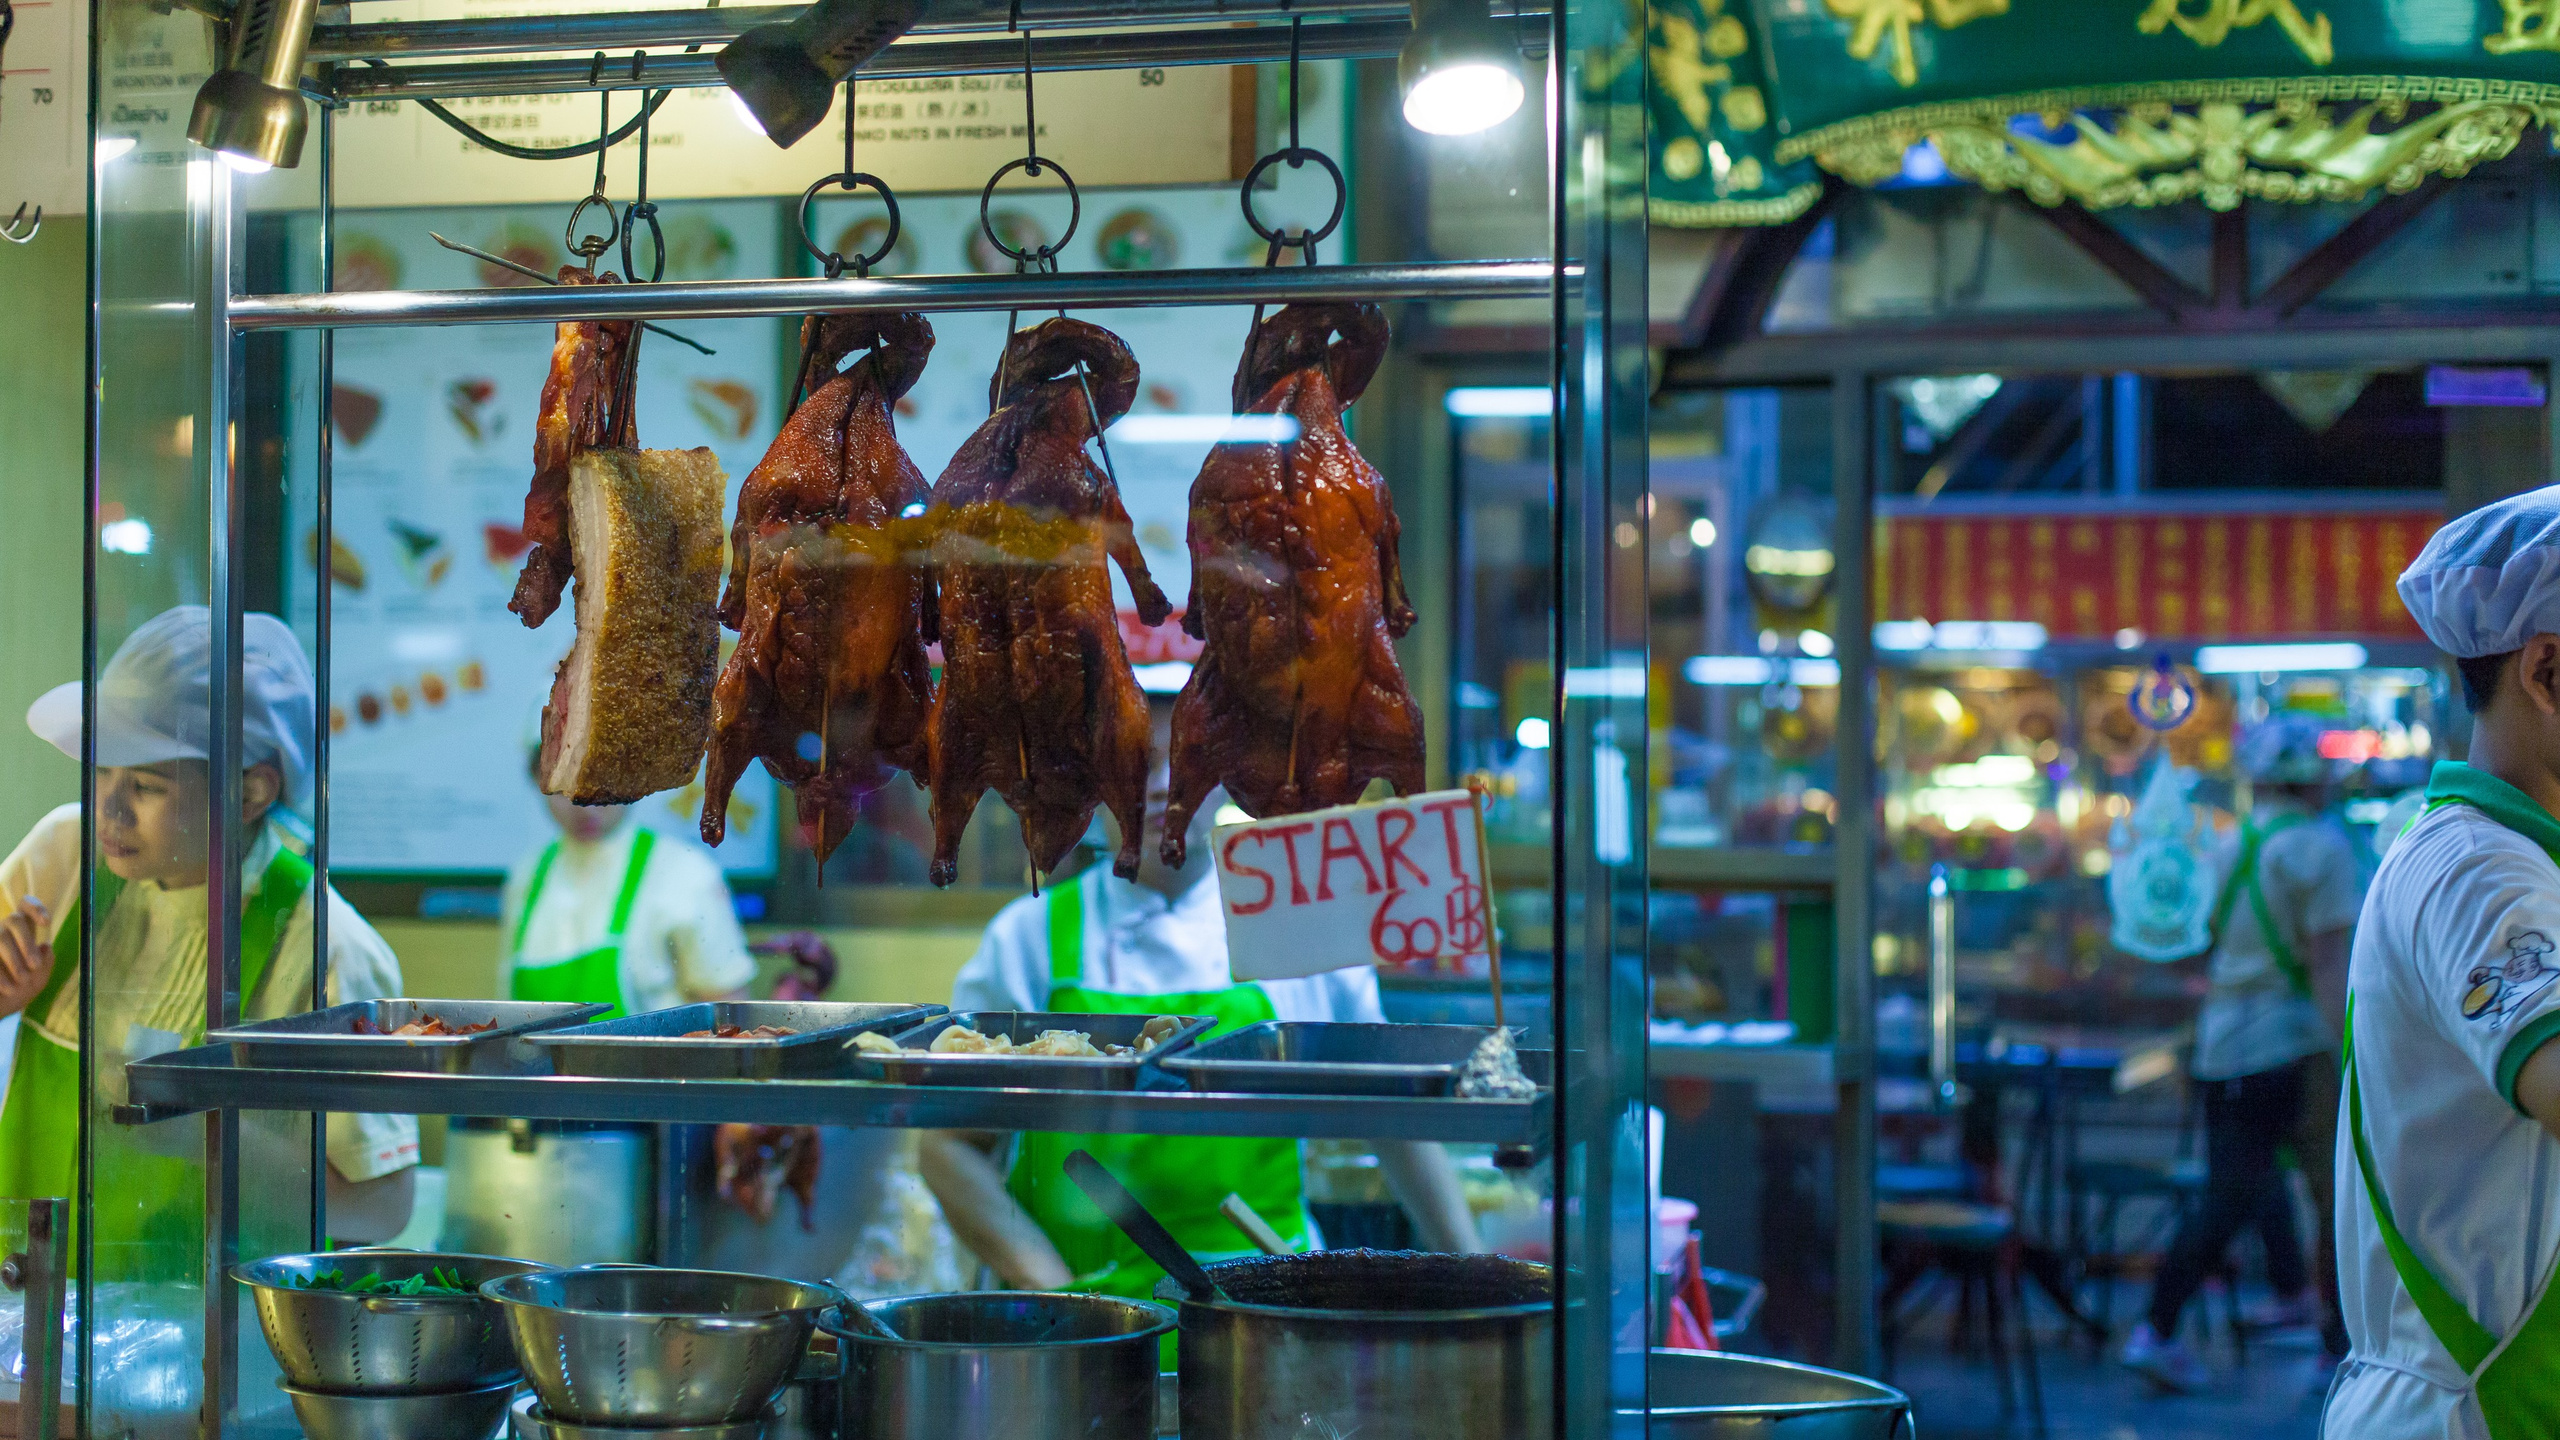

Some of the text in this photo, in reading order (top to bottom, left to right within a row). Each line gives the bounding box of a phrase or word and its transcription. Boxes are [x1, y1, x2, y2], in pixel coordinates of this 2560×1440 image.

[1139, 68, 1165, 86] 50
[32, 87, 54, 105] 70
[838, 127, 886, 142] GNKO
[955, 124, 1007, 140] FRESH
[1010, 123, 1048, 138] MIK
[1222, 798, 1474, 917] START
